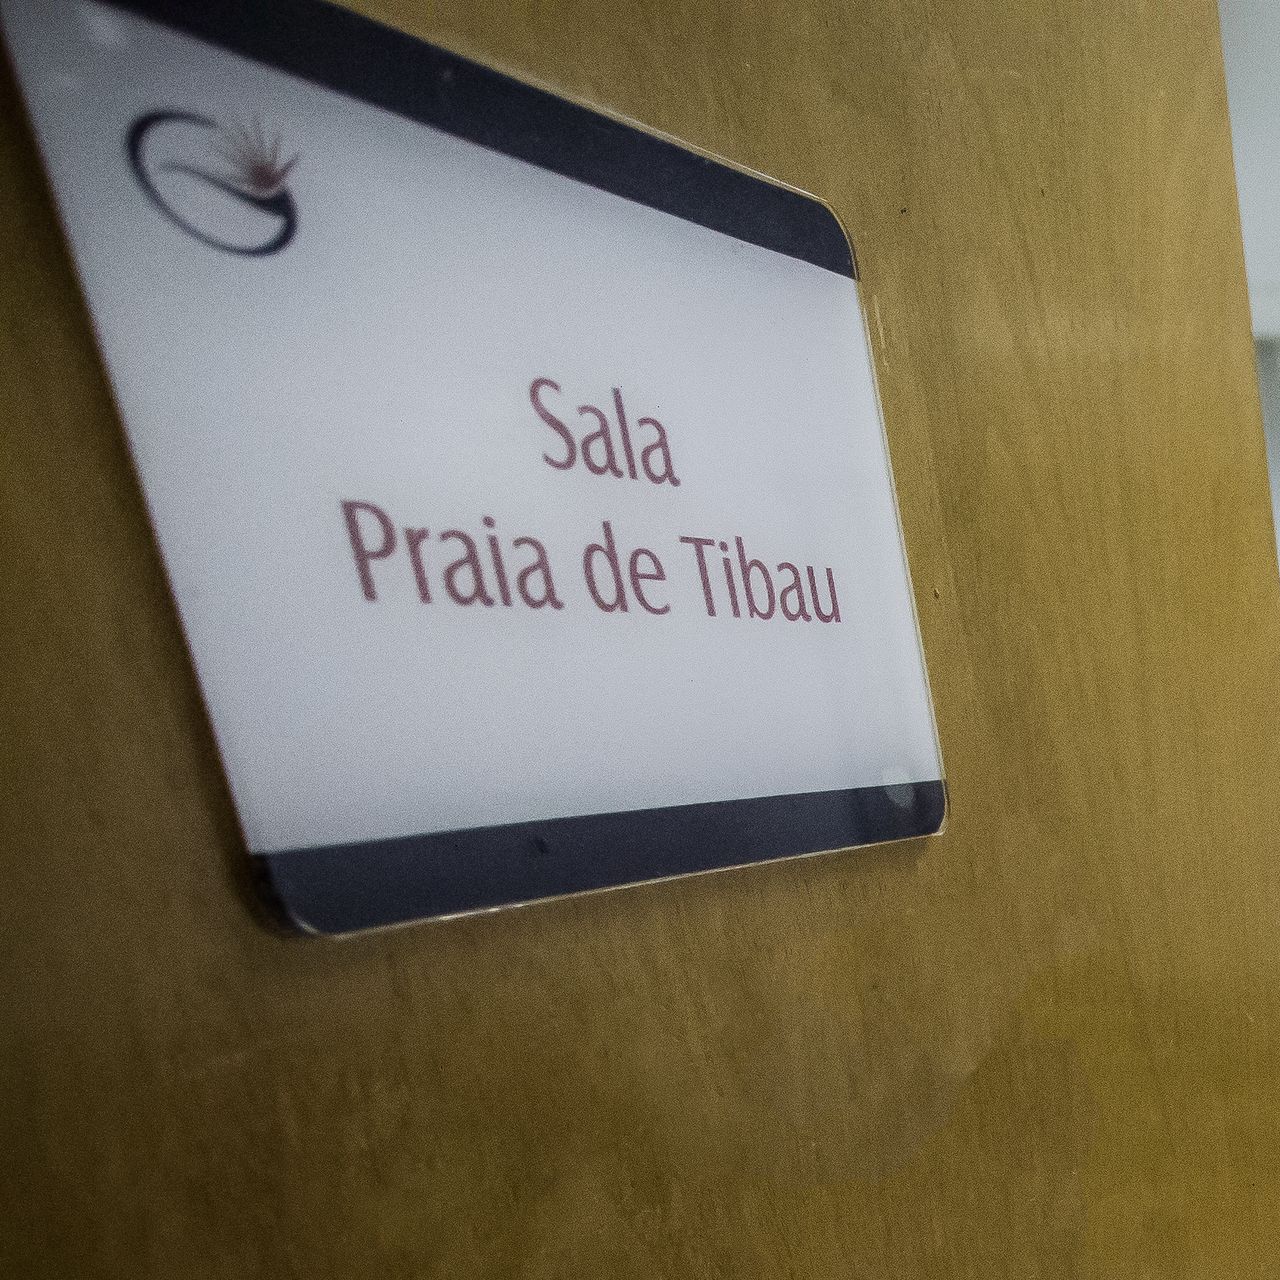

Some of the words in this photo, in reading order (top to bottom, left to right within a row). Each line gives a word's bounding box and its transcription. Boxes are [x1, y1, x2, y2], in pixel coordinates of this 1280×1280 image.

[529, 377, 680, 488] Sala
[341, 499, 564, 611] Praia
[583, 520, 672, 616] de
[680, 535, 843, 625] Tibau
